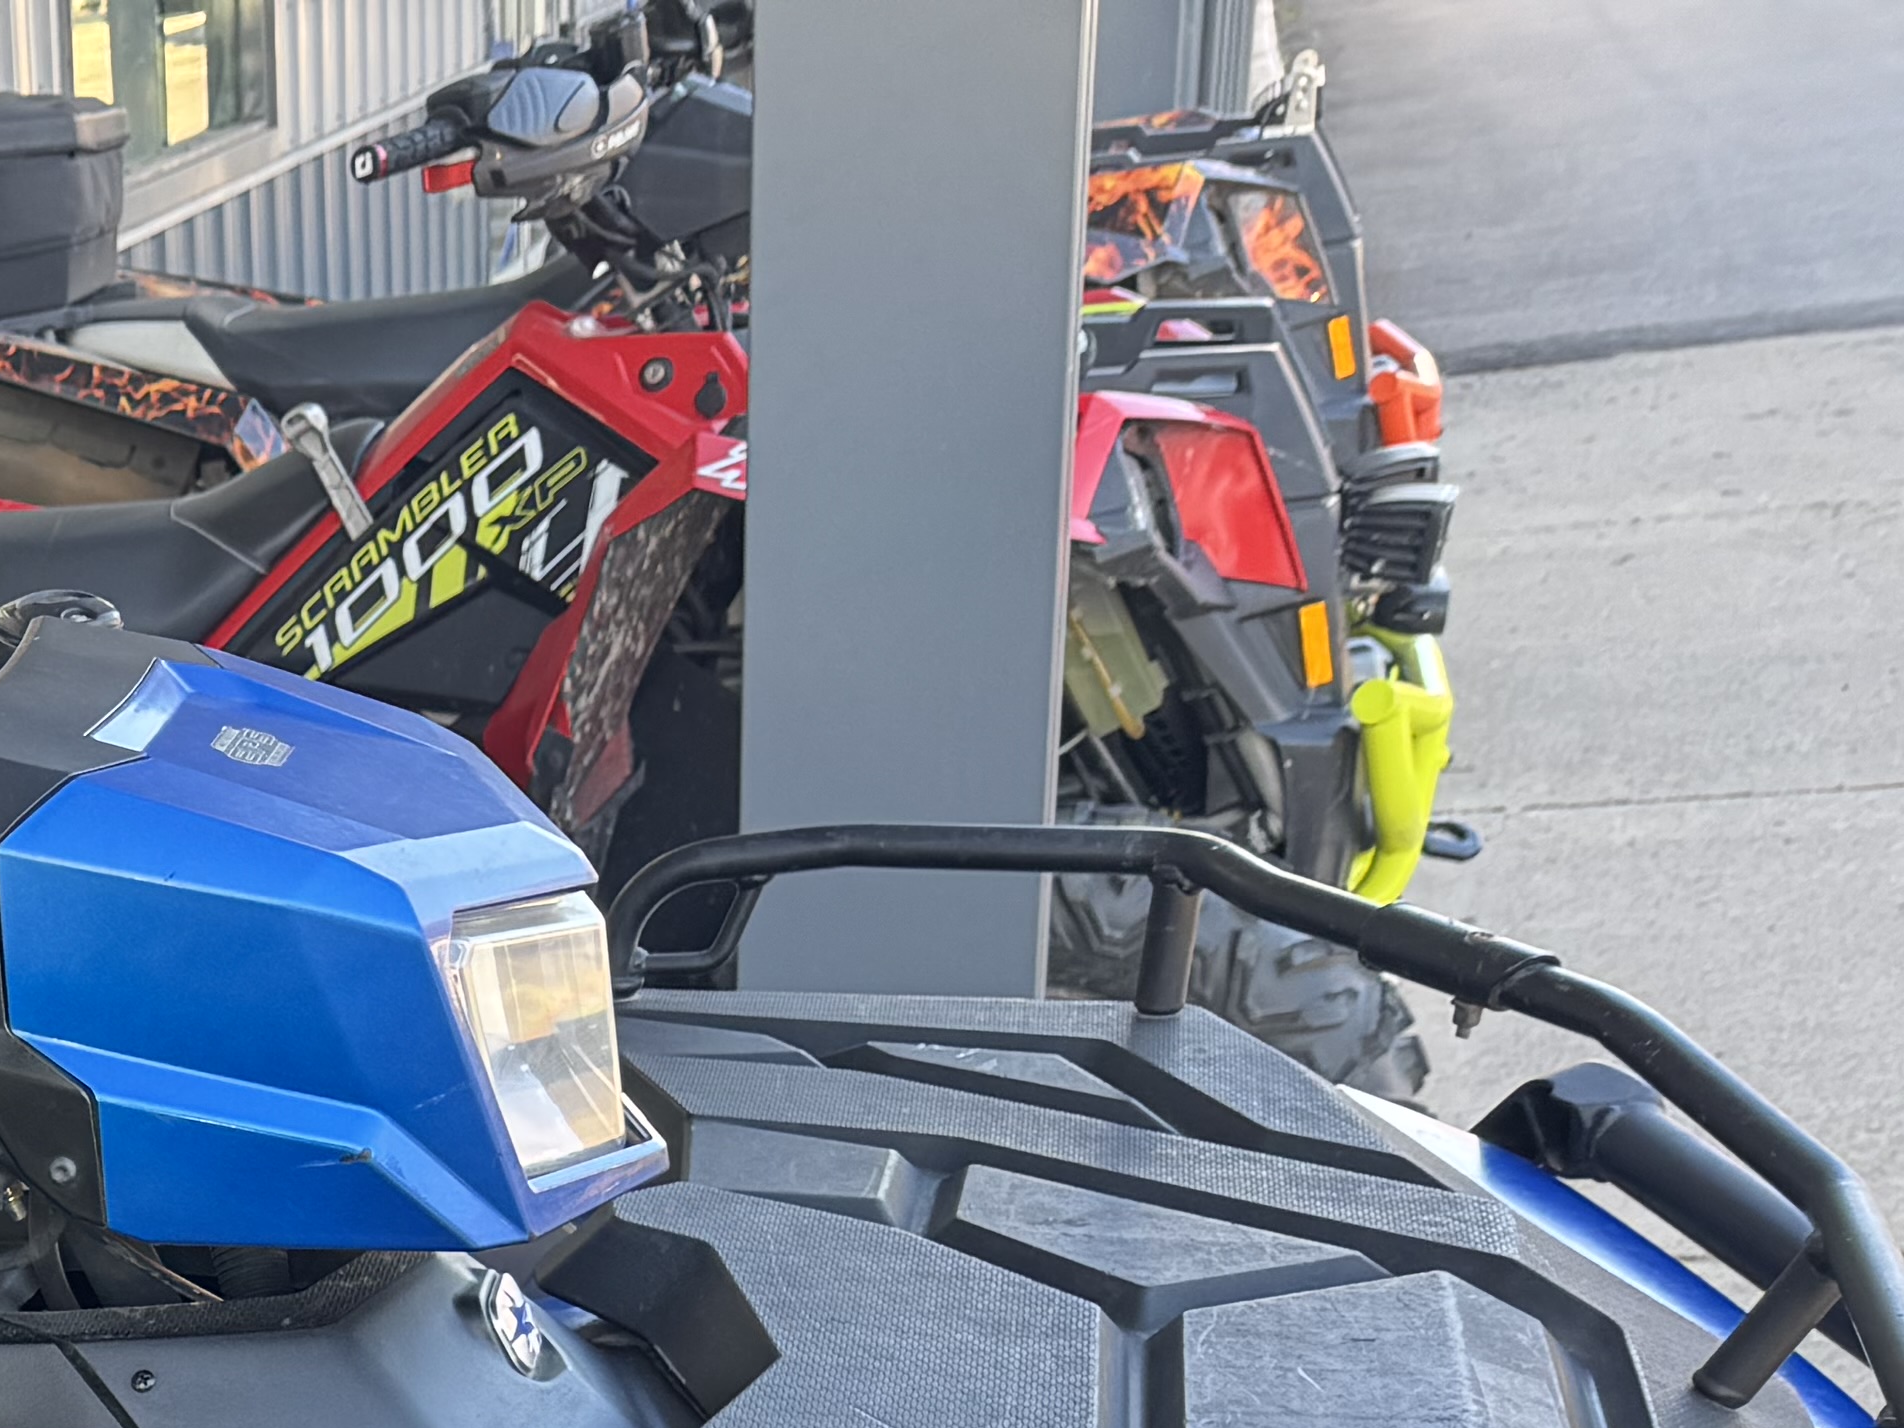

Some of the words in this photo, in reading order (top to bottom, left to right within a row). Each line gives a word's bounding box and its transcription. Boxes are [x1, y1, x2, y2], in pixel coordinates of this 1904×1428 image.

[275, 412, 519, 655] SCRAMBLER
[302, 426, 544, 672] 1000
[485, 446, 588, 546] XP
